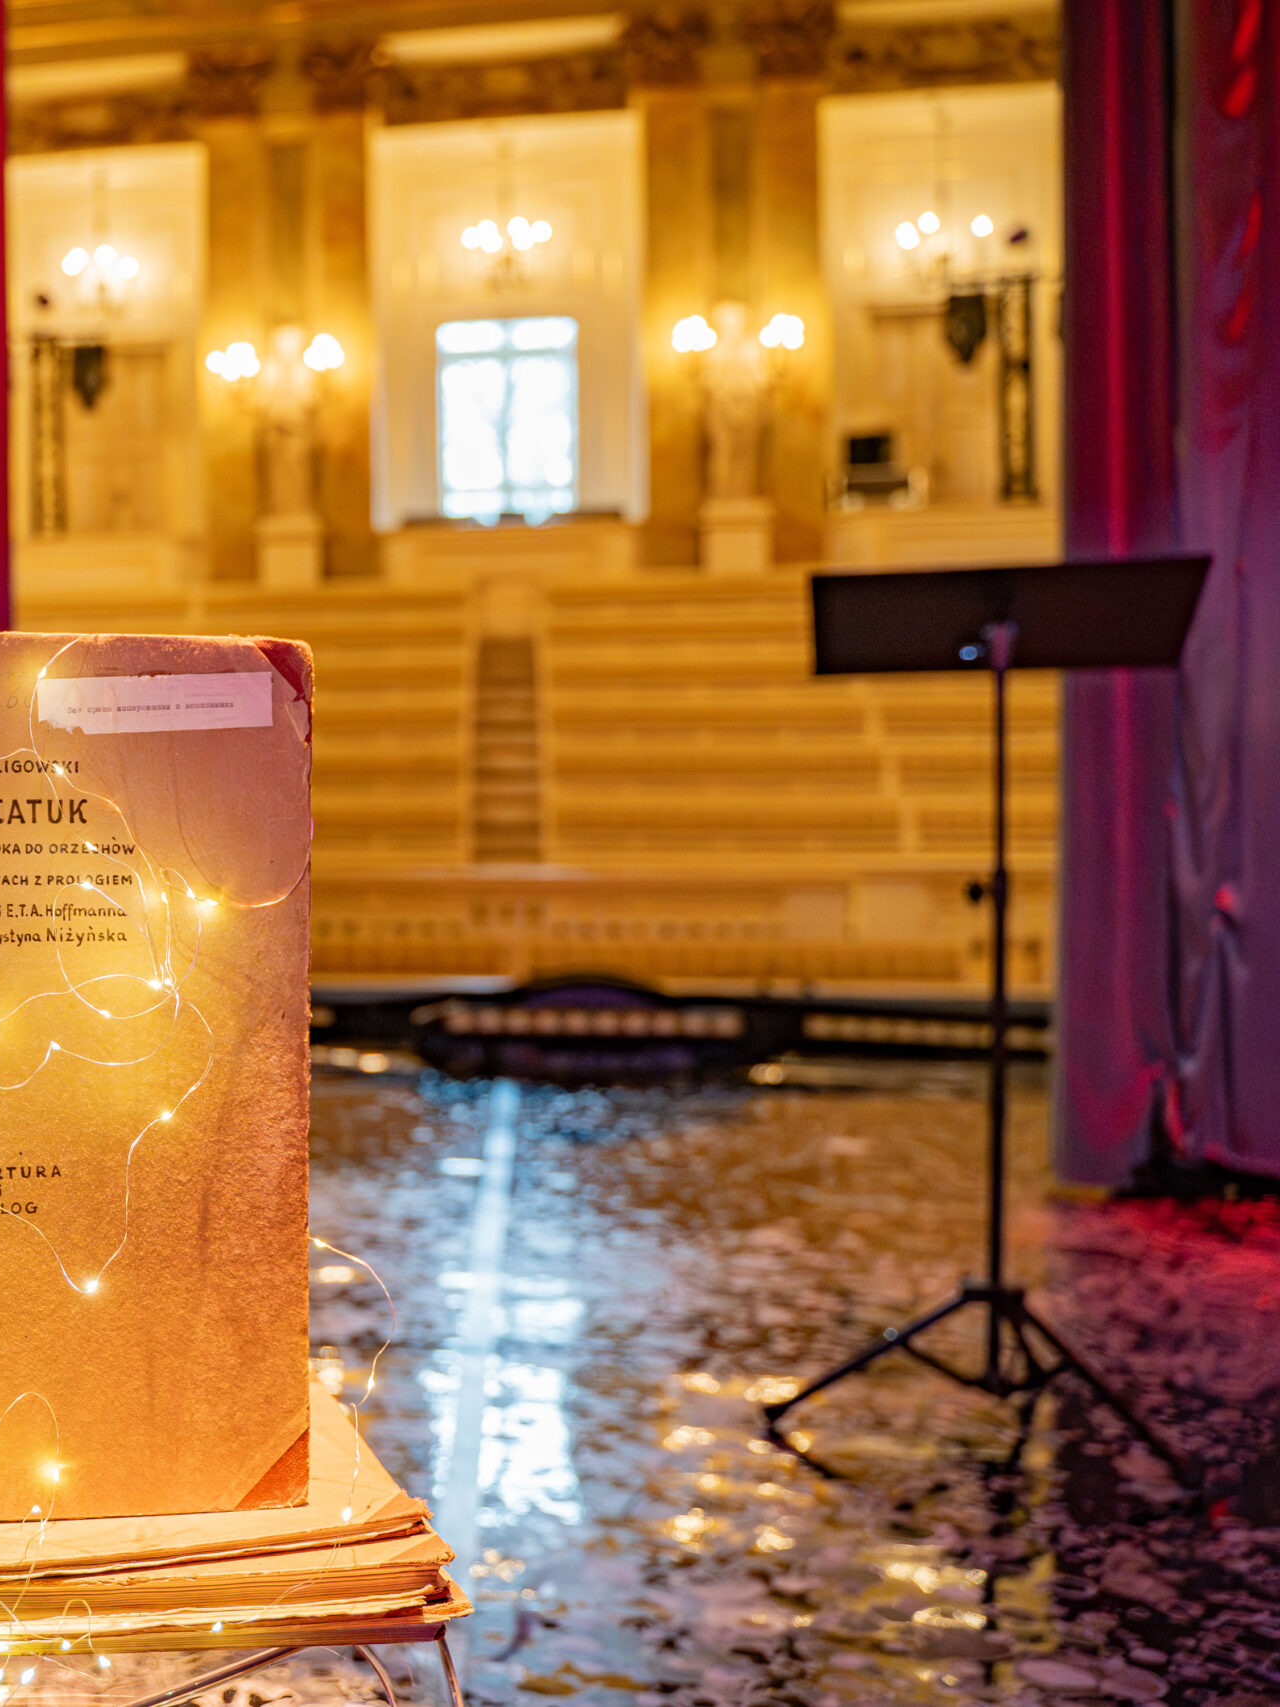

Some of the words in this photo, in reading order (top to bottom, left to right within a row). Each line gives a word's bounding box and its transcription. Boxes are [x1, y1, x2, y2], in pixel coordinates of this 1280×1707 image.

[25, 843, 43, 854] DO
[34, 875, 43, 886] Z
[47, 874, 133, 886] PROLOGIEM
[6, 903, 43, 918] E.T.A.
[45, 903, 128, 921] Hoffmanna
